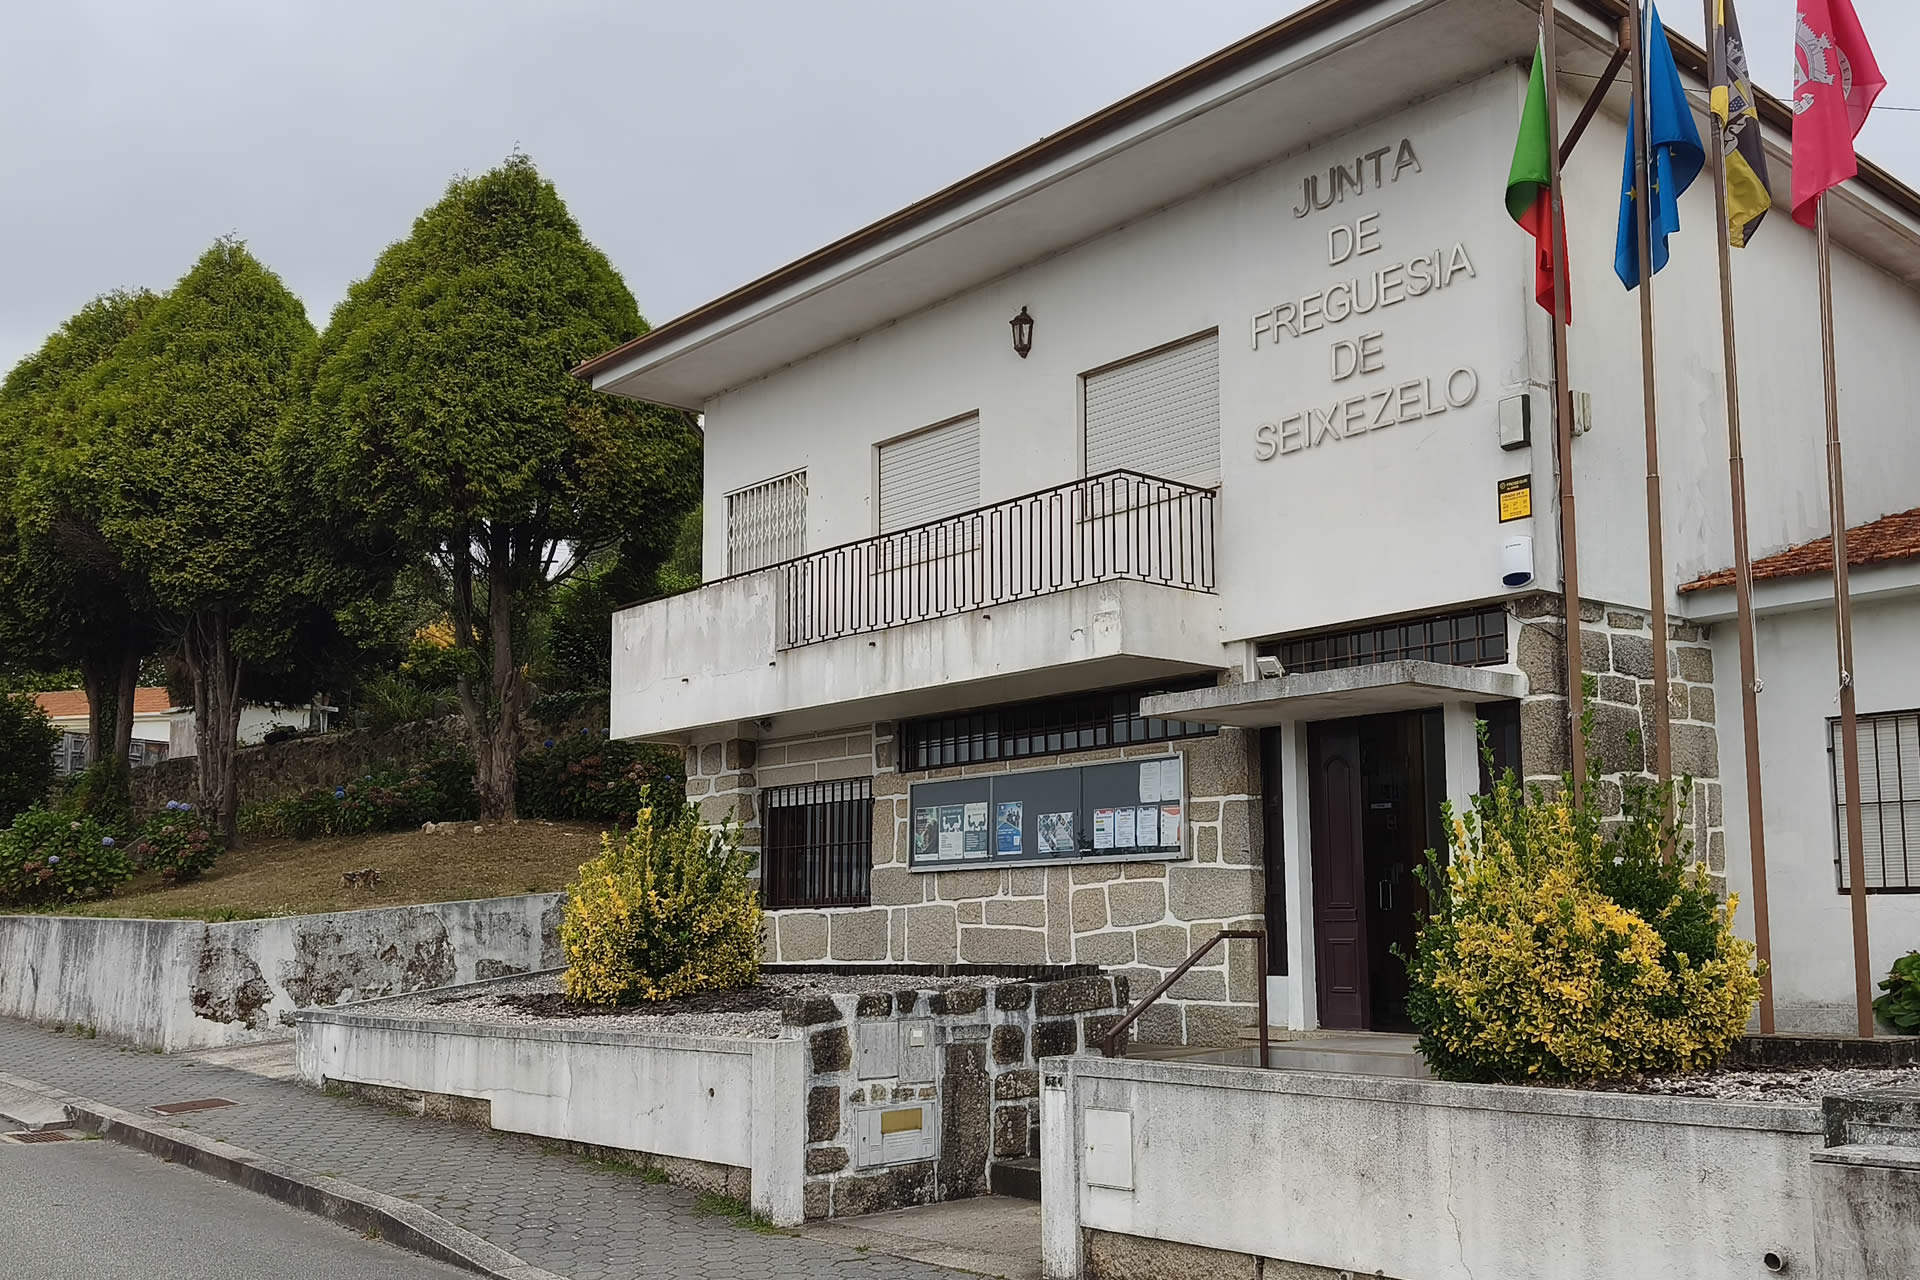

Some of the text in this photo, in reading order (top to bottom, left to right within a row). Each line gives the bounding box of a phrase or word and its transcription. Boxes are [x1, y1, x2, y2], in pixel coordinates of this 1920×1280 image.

[1293, 138, 1422, 219] JUNTA
[1327, 211, 1381, 266] DE
[1250, 240, 1476, 350] FREGUESIA
[1330, 330, 1384, 382] DE
[1255, 366, 1478, 462] SEIXEZELO
